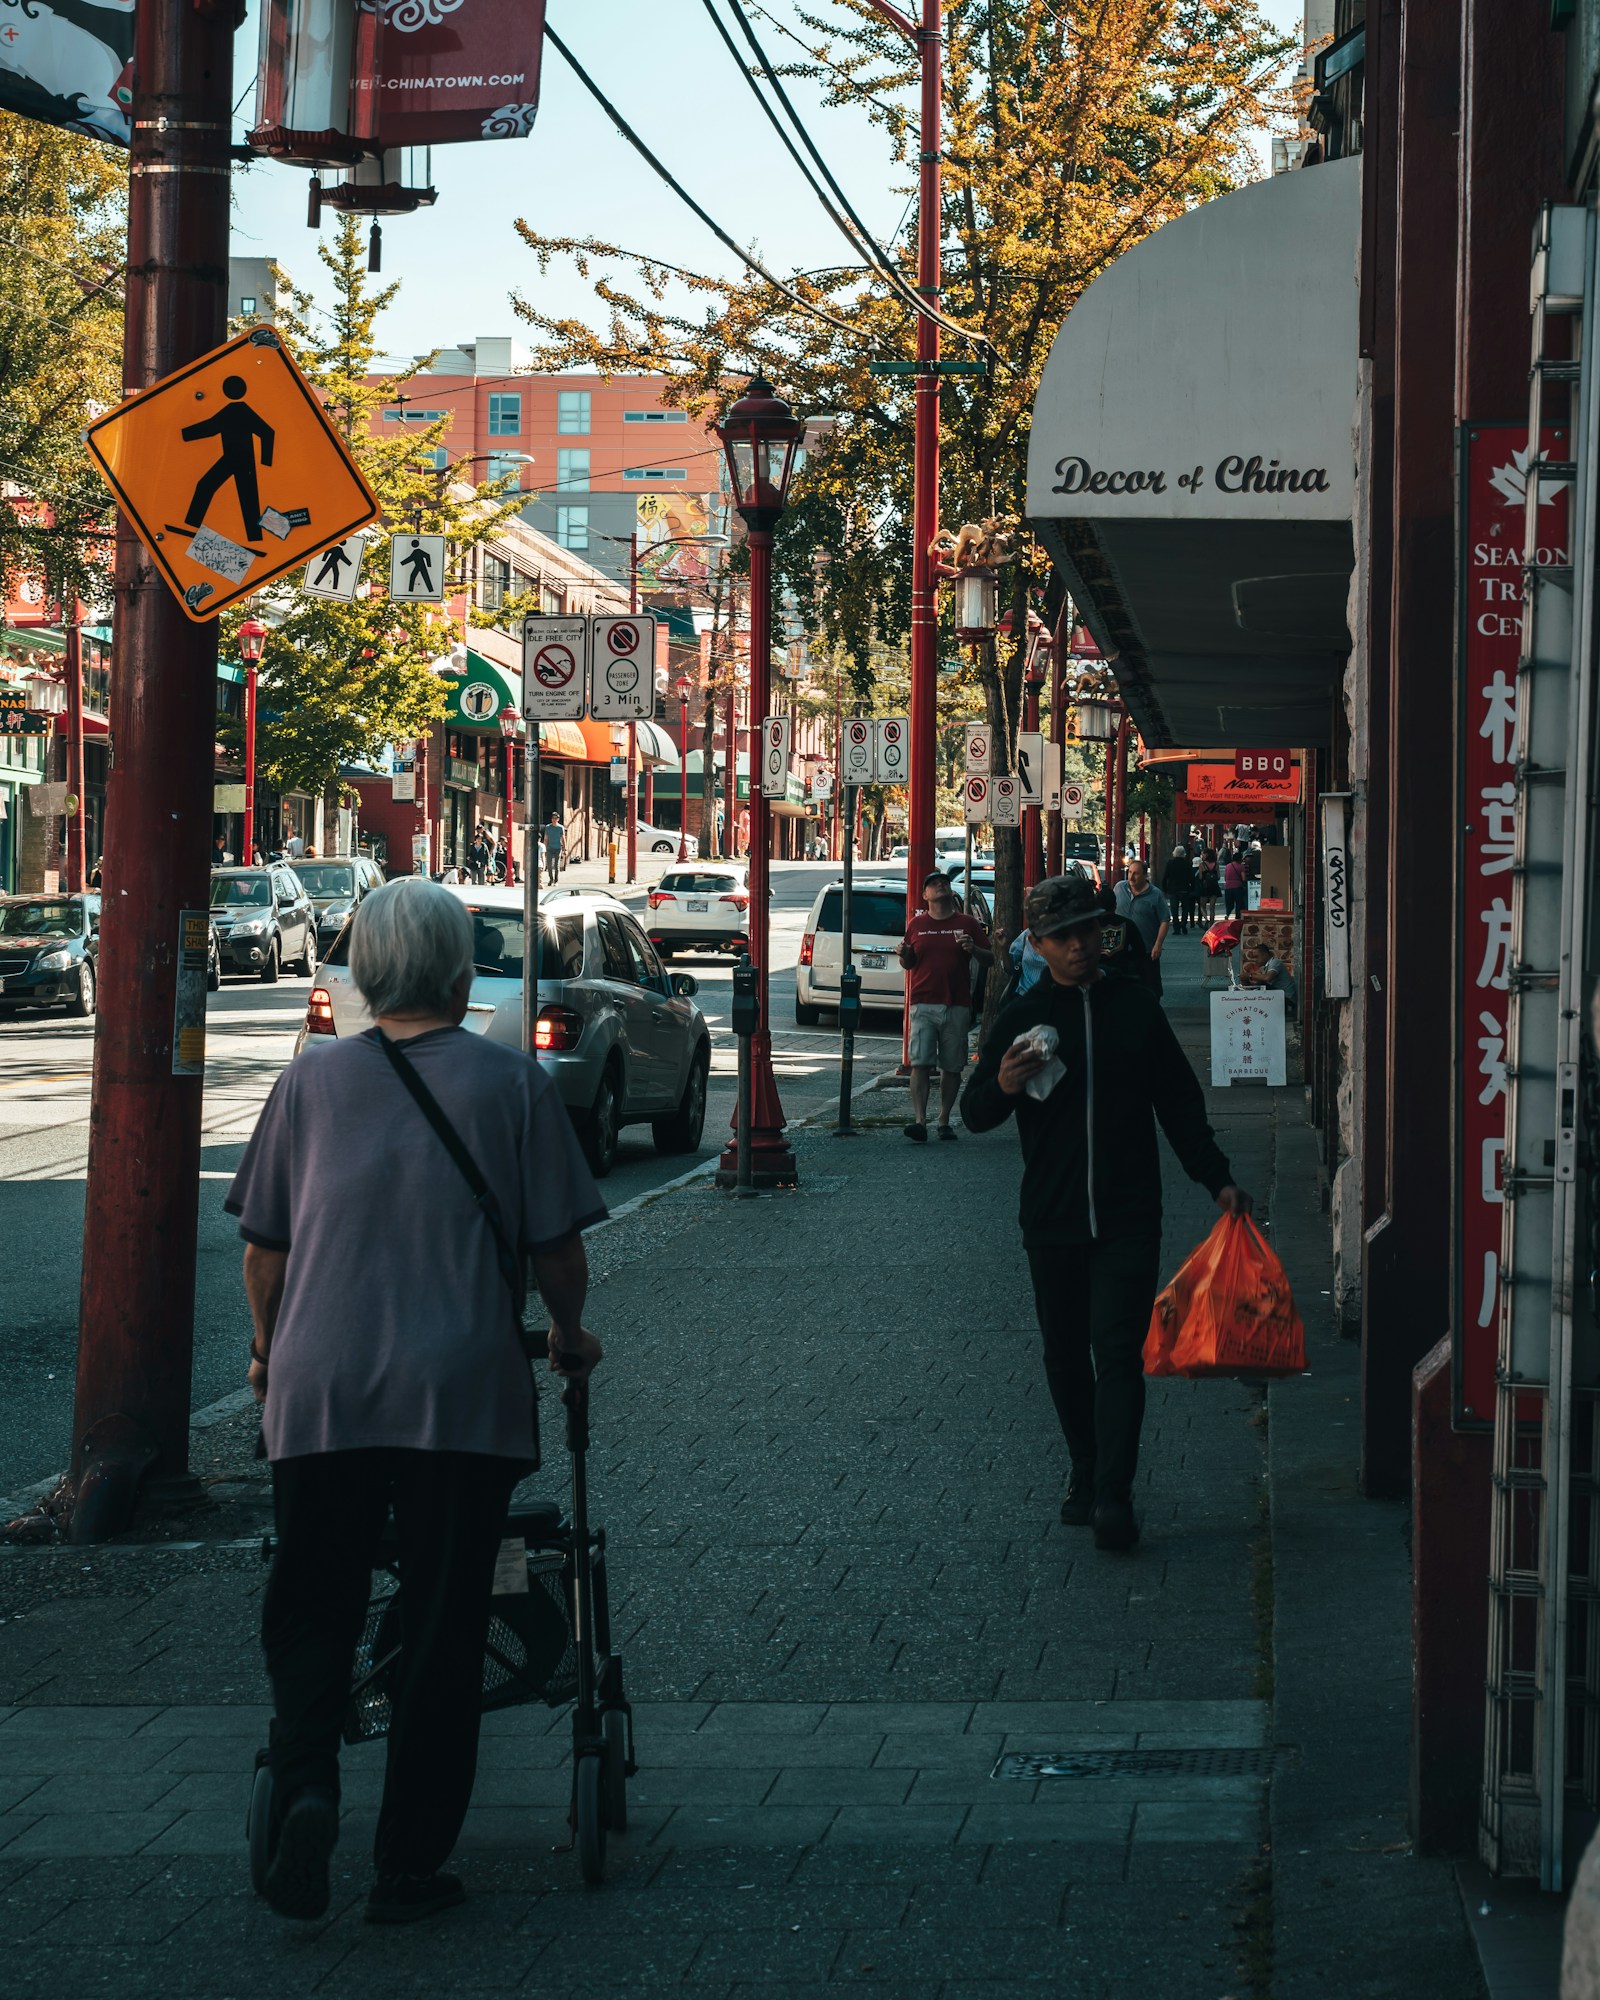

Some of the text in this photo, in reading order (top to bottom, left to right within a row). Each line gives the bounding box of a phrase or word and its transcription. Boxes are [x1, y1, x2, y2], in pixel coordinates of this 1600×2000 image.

[1051, 454, 1331, 495] Decor of China
[604, 694, 640, 705] 3 Min
[1242, 756, 1285, 773] BBQ
[1223, 779, 1256, 790] New
[1255, 779, 1292, 790] Town
[1226, 1006, 1269, 1020] CHINATOWN
